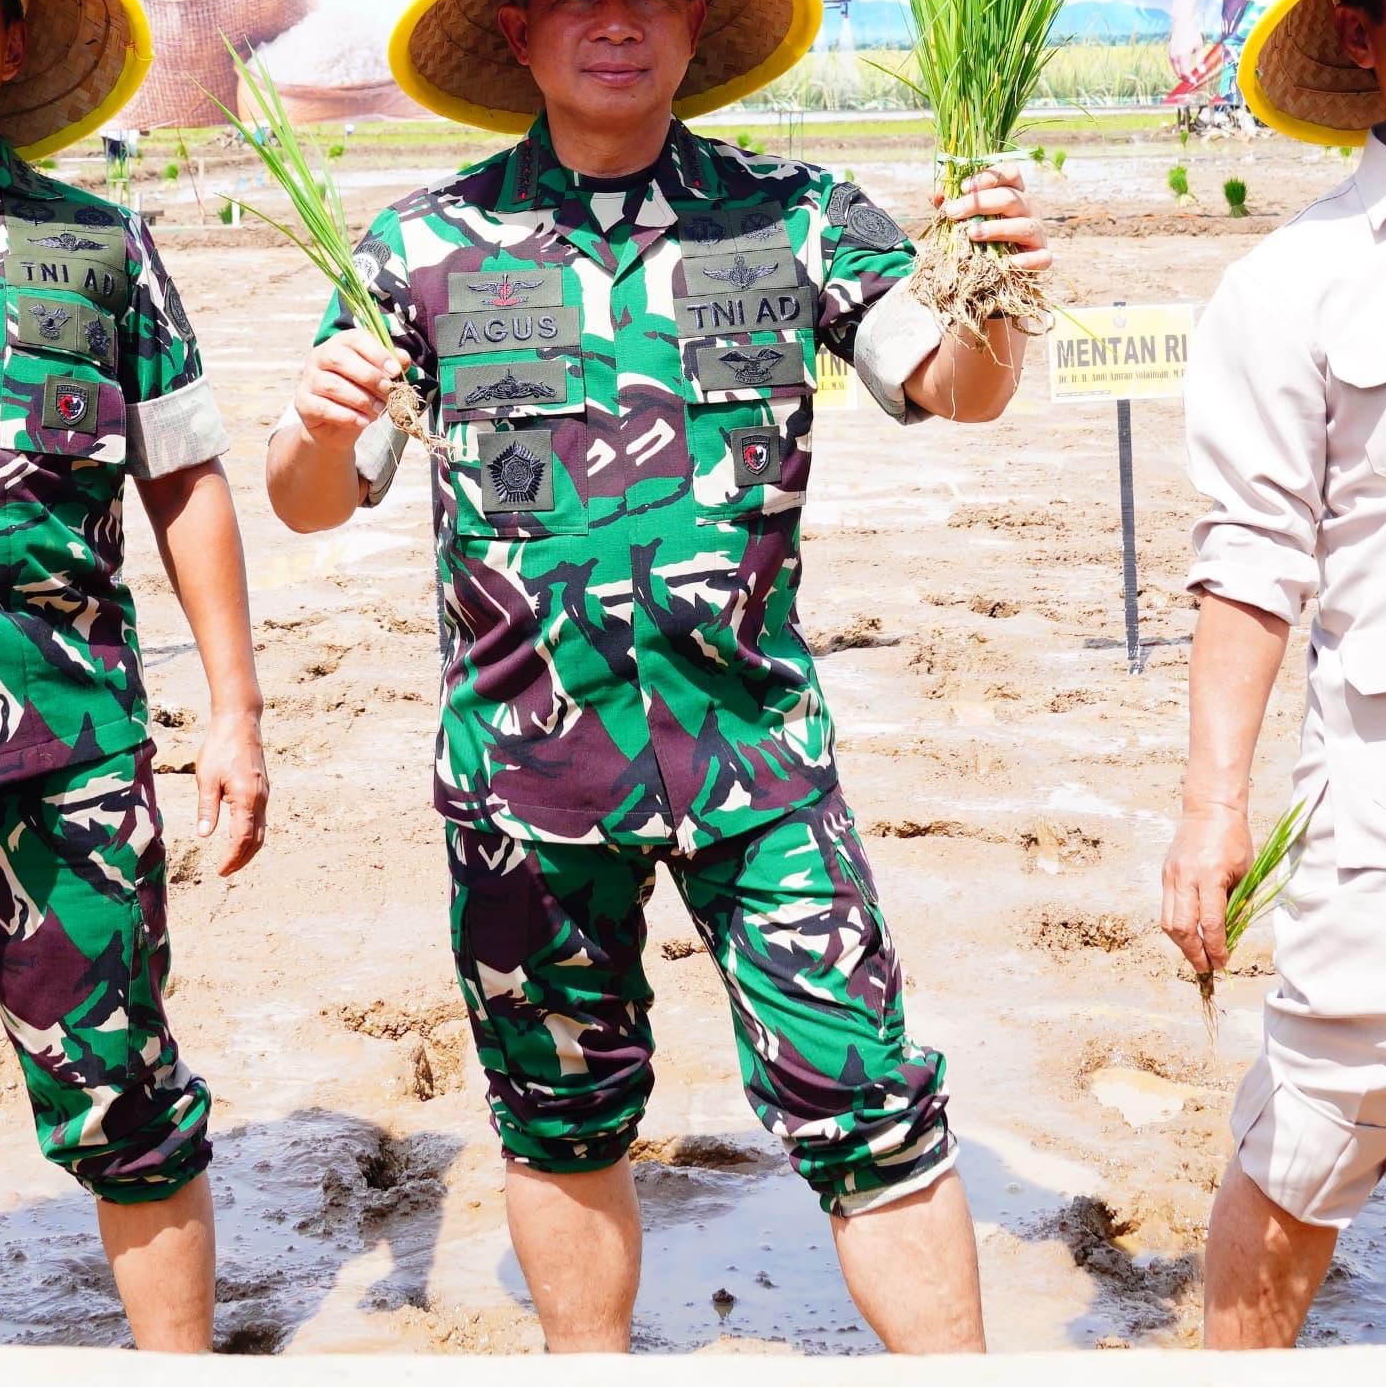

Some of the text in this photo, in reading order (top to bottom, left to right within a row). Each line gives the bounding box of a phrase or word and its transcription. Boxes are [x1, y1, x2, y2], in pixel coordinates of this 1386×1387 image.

[20, 260, 115, 298] TNI AD
[686, 294, 803, 330] TNI AD
[457, 314, 559, 349] AGUS
[1056, 332, 1189, 370] MENTAN RI
